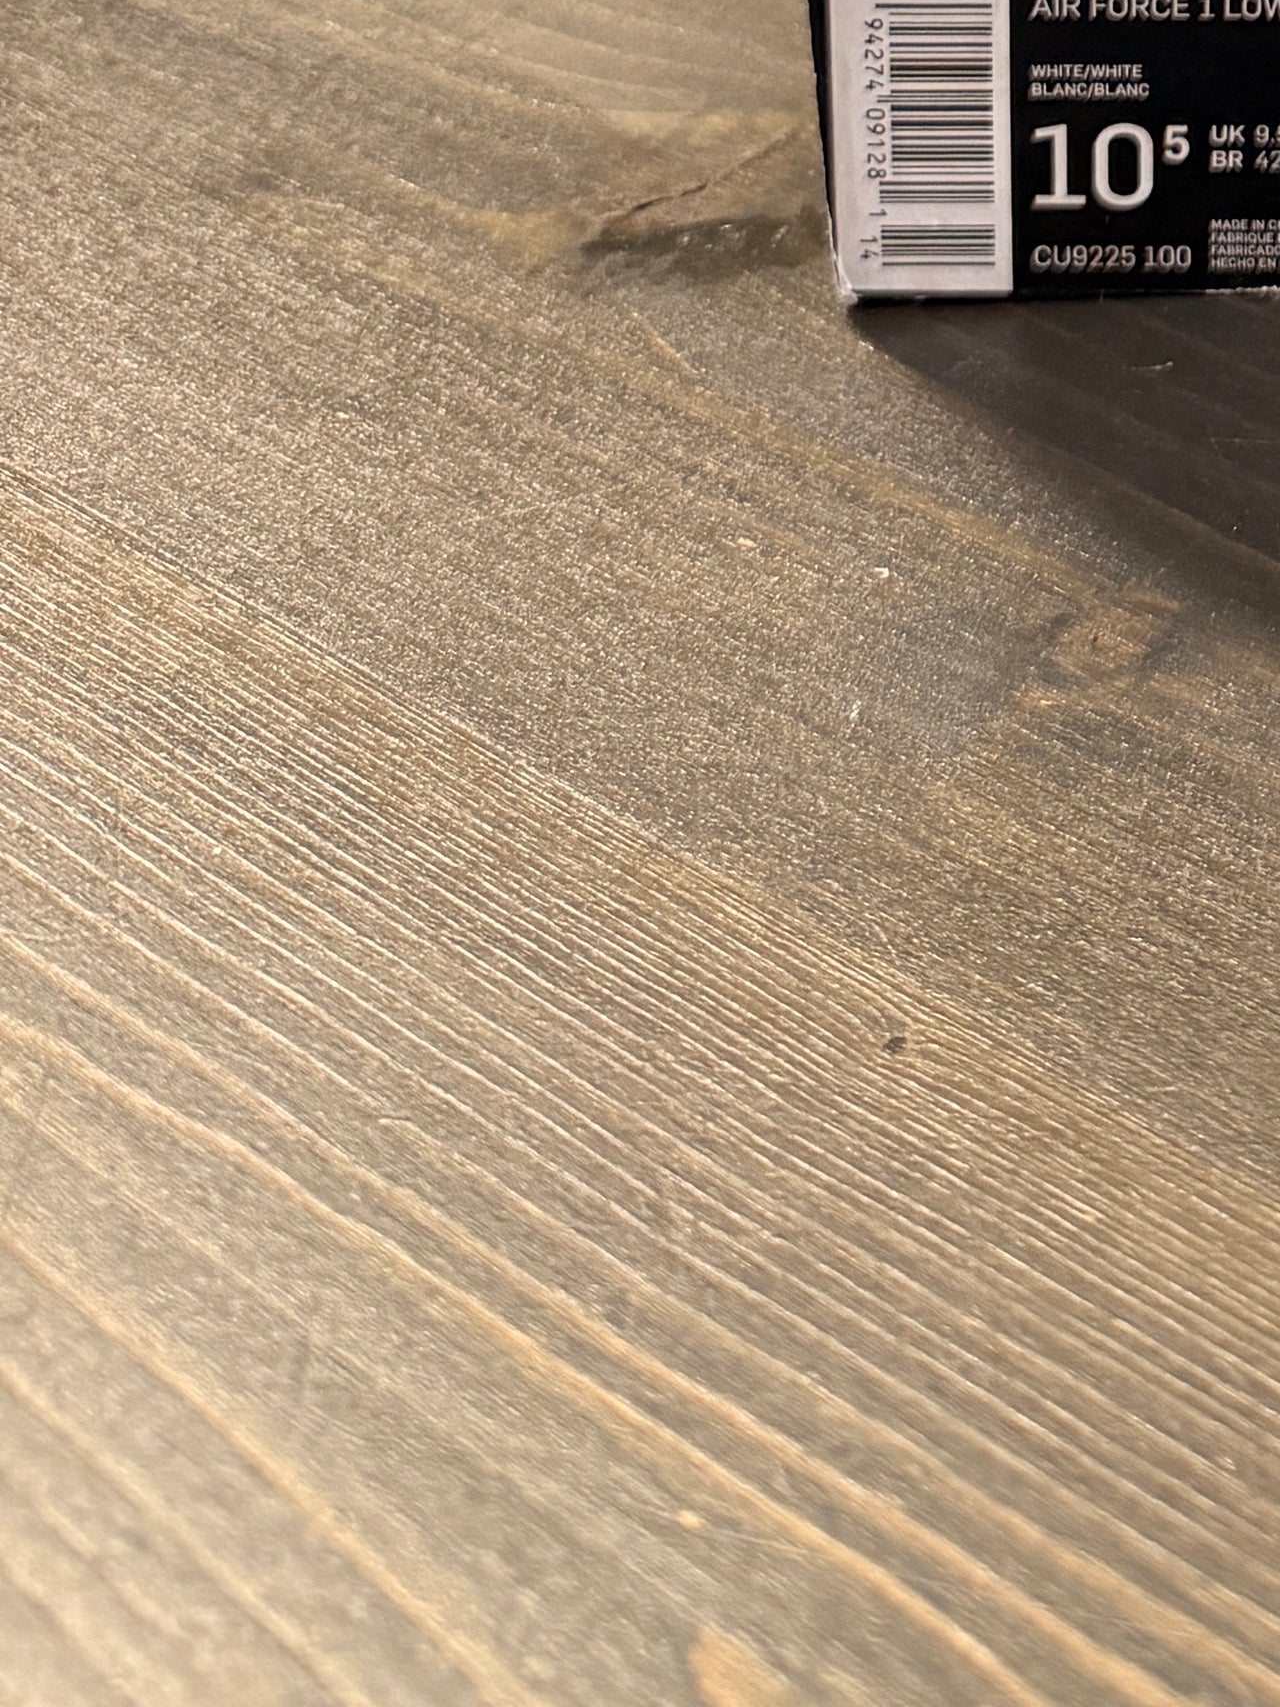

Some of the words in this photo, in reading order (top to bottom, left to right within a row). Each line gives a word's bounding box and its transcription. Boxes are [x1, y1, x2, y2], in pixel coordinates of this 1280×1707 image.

[863, 18, 885, 91] 94274
[1029, 63, 1143, 81] WHITE/WHITE
[1028, 81, 1150, 101] BLANC/BLANC
[864, 107, 888, 180] 09128
[1208, 124, 1246, 147] UK
[1208, 149, 1244, 173] BR
[1209, 218, 1249, 232] MADE
[1252, 219, 1265, 232] IN
[1209, 231, 1274, 245] FABRIQUE
[1029, 244, 1137, 274] CU9225
[1142, 245, 1192, 274] 100
[1209, 256, 1256, 272] HECHO
[1257, 257, 1276, 273] EN
